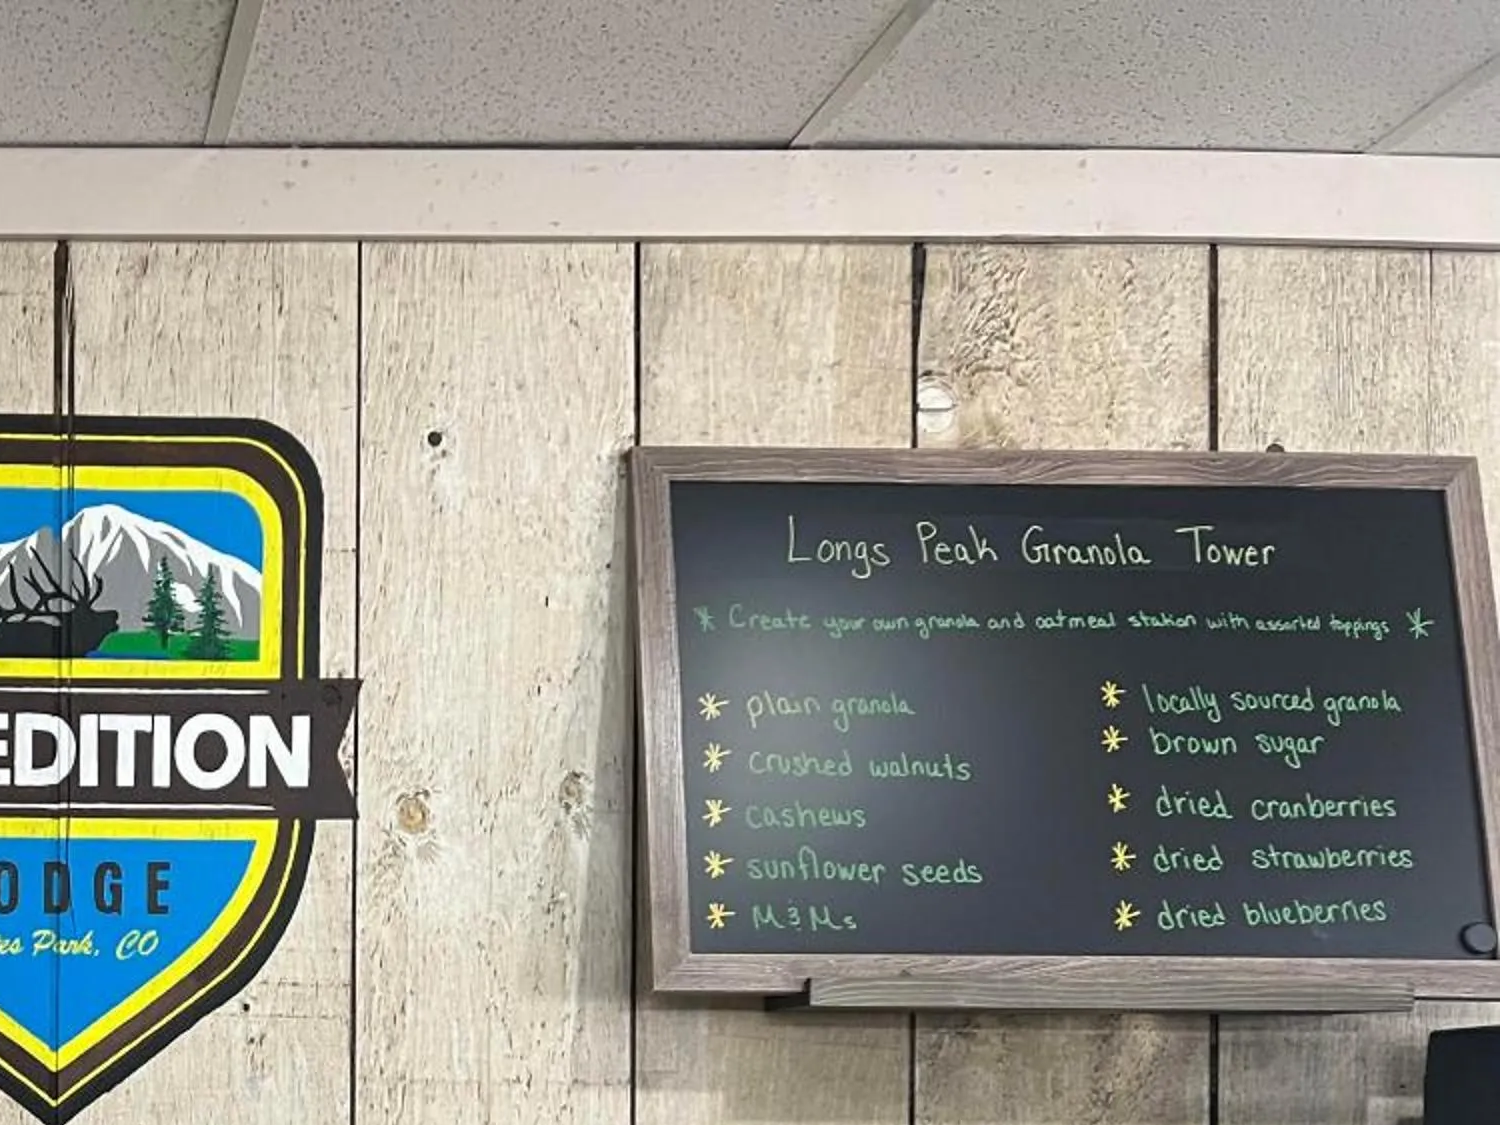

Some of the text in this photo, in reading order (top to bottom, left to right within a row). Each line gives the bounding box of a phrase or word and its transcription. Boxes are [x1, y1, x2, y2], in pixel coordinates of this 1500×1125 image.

[787, 515, 1275, 578] Longs Peak Granola Tower
[729, 603, 1390, 641] Create your own granola and oatmeal station with assorted toppings
[747, 690, 916, 733] plain granola
[1142, 683, 1401, 726] locally sourced granola
[869, 752, 971, 781] walnuts
[1149, 727, 1324, 769] brown sugar
[1156, 785, 1397, 820] dried cranberries
[747, 846, 983, 886] sunflower seeds
[1153, 844, 1413, 872] dried strawberries
[1157, 899, 1387, 930] dried blueberries
[31, 929, 100, 957] Park,
[116, 929, 159, 960] CO
